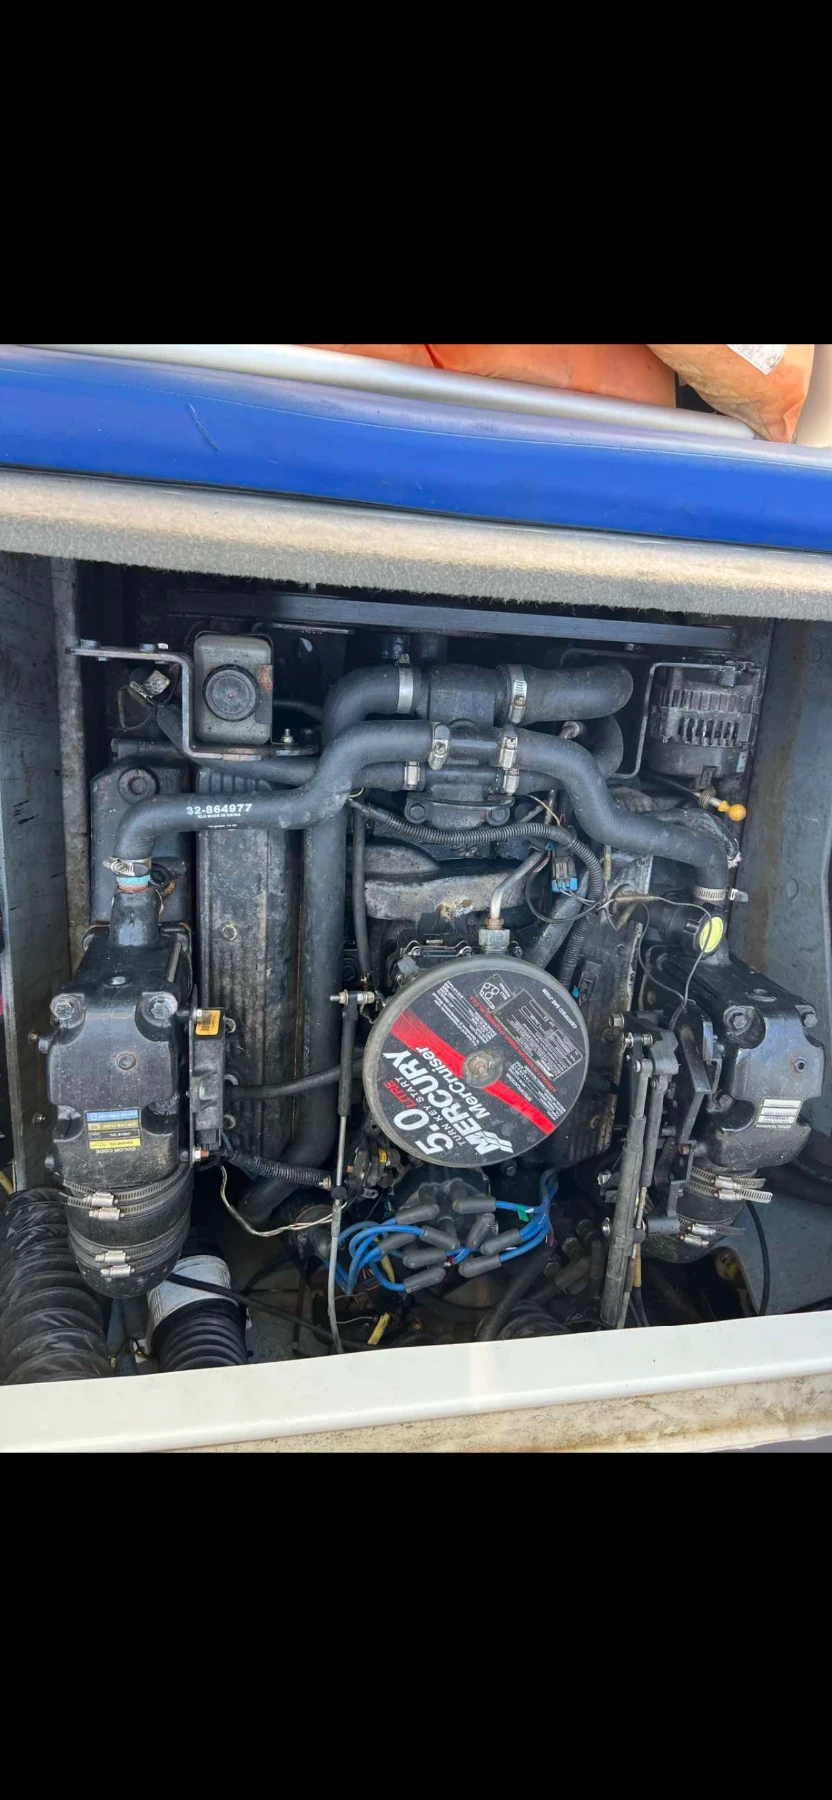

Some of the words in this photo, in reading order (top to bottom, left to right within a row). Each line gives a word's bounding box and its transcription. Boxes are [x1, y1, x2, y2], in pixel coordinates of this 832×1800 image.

[187, 803, 252, 815] 32-864977
[557, 1006, 578, 1029] CERTIFIED
[383, 1079, 416, 1109] LITRE
[394, 1075, 424, 1103] START
[415, 1044, 490, 1119] MerCruiser
[382, 1048, 513, 1155] MERCURY
[422, 1103, 443, 1122] KEY
[394, 1107, 452, 1156] 5.0
[441, 1123, 466, 1146] TURN
